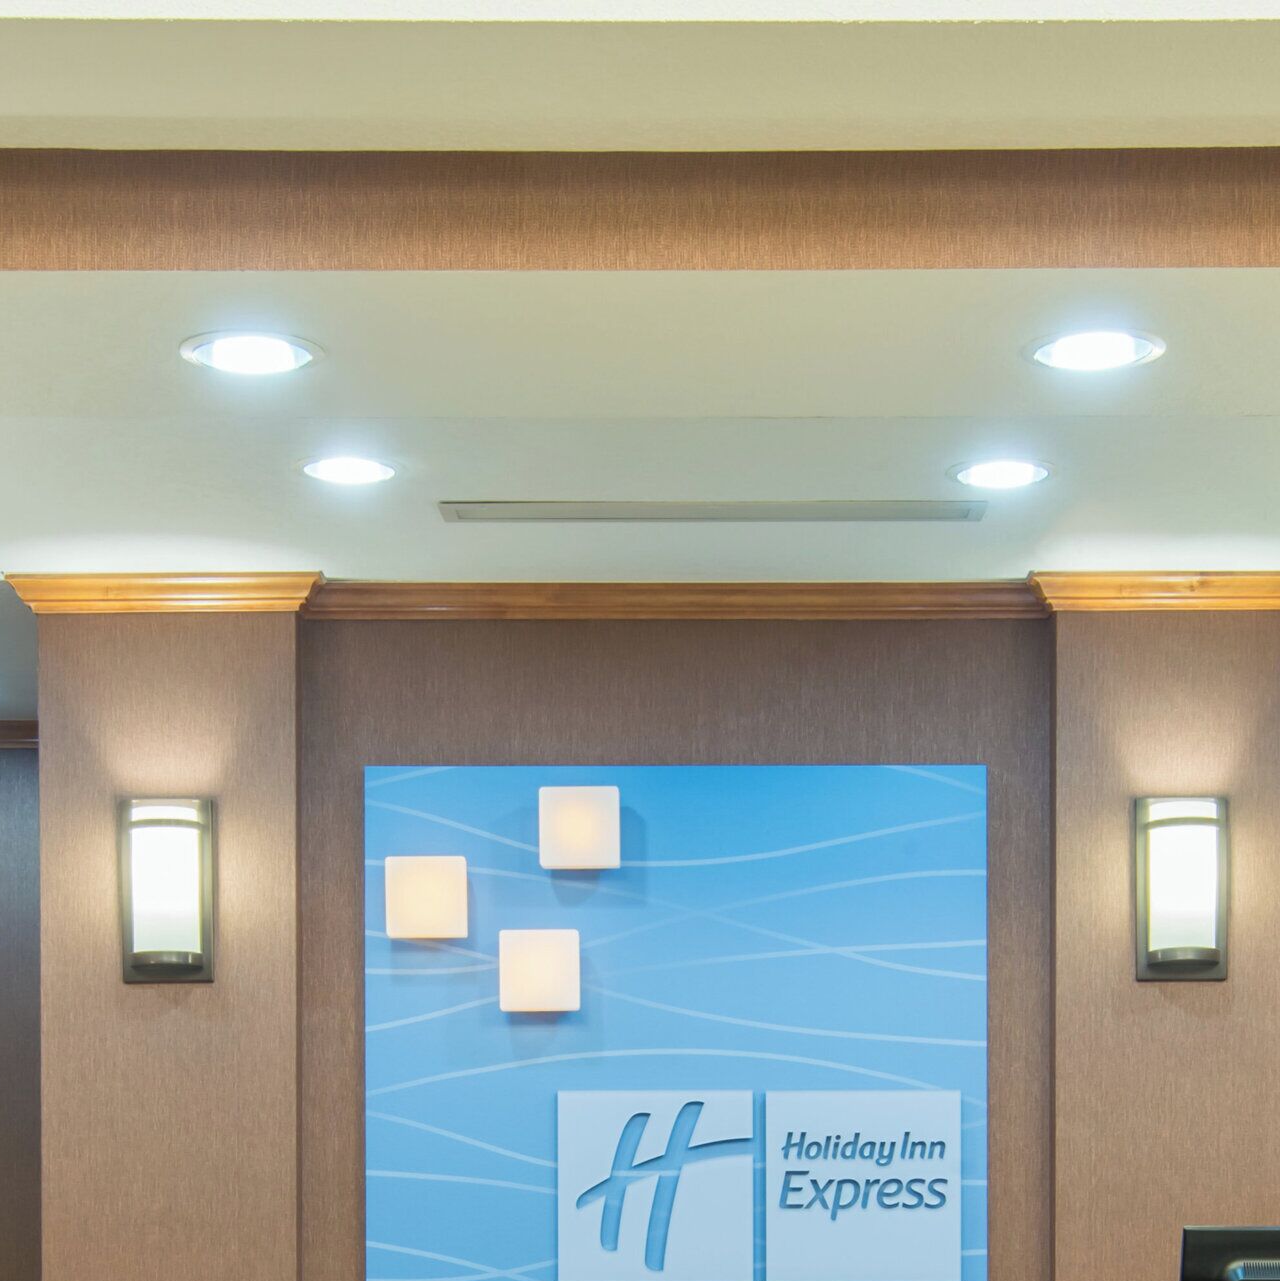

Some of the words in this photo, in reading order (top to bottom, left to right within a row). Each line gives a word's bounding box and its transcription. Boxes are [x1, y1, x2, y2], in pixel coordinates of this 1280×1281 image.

[781, 1131, 897, 1166] Holiday
[901, 1131, 947, 1160] Inn
[779, 1170, 949, 1221] Express
